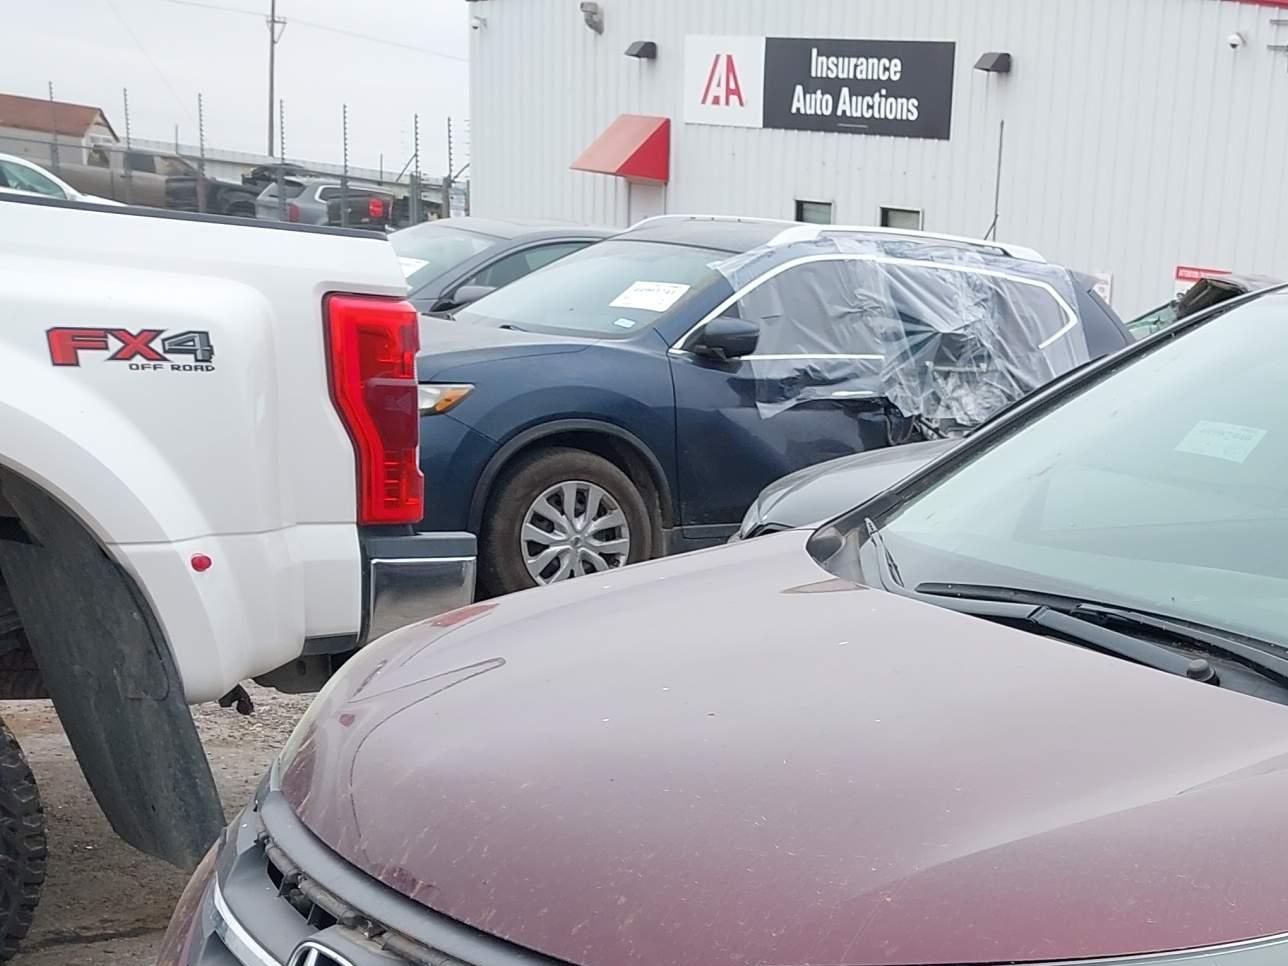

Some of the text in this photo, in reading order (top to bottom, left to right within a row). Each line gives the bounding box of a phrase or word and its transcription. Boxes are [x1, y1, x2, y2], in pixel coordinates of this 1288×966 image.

[810, 47, 902, 81] Insurance
[791, 84, 919, 121] Auto Auctions
[46, 326, 215, 367] FX4
[128, 363, 216, 372] OFF ROAD
